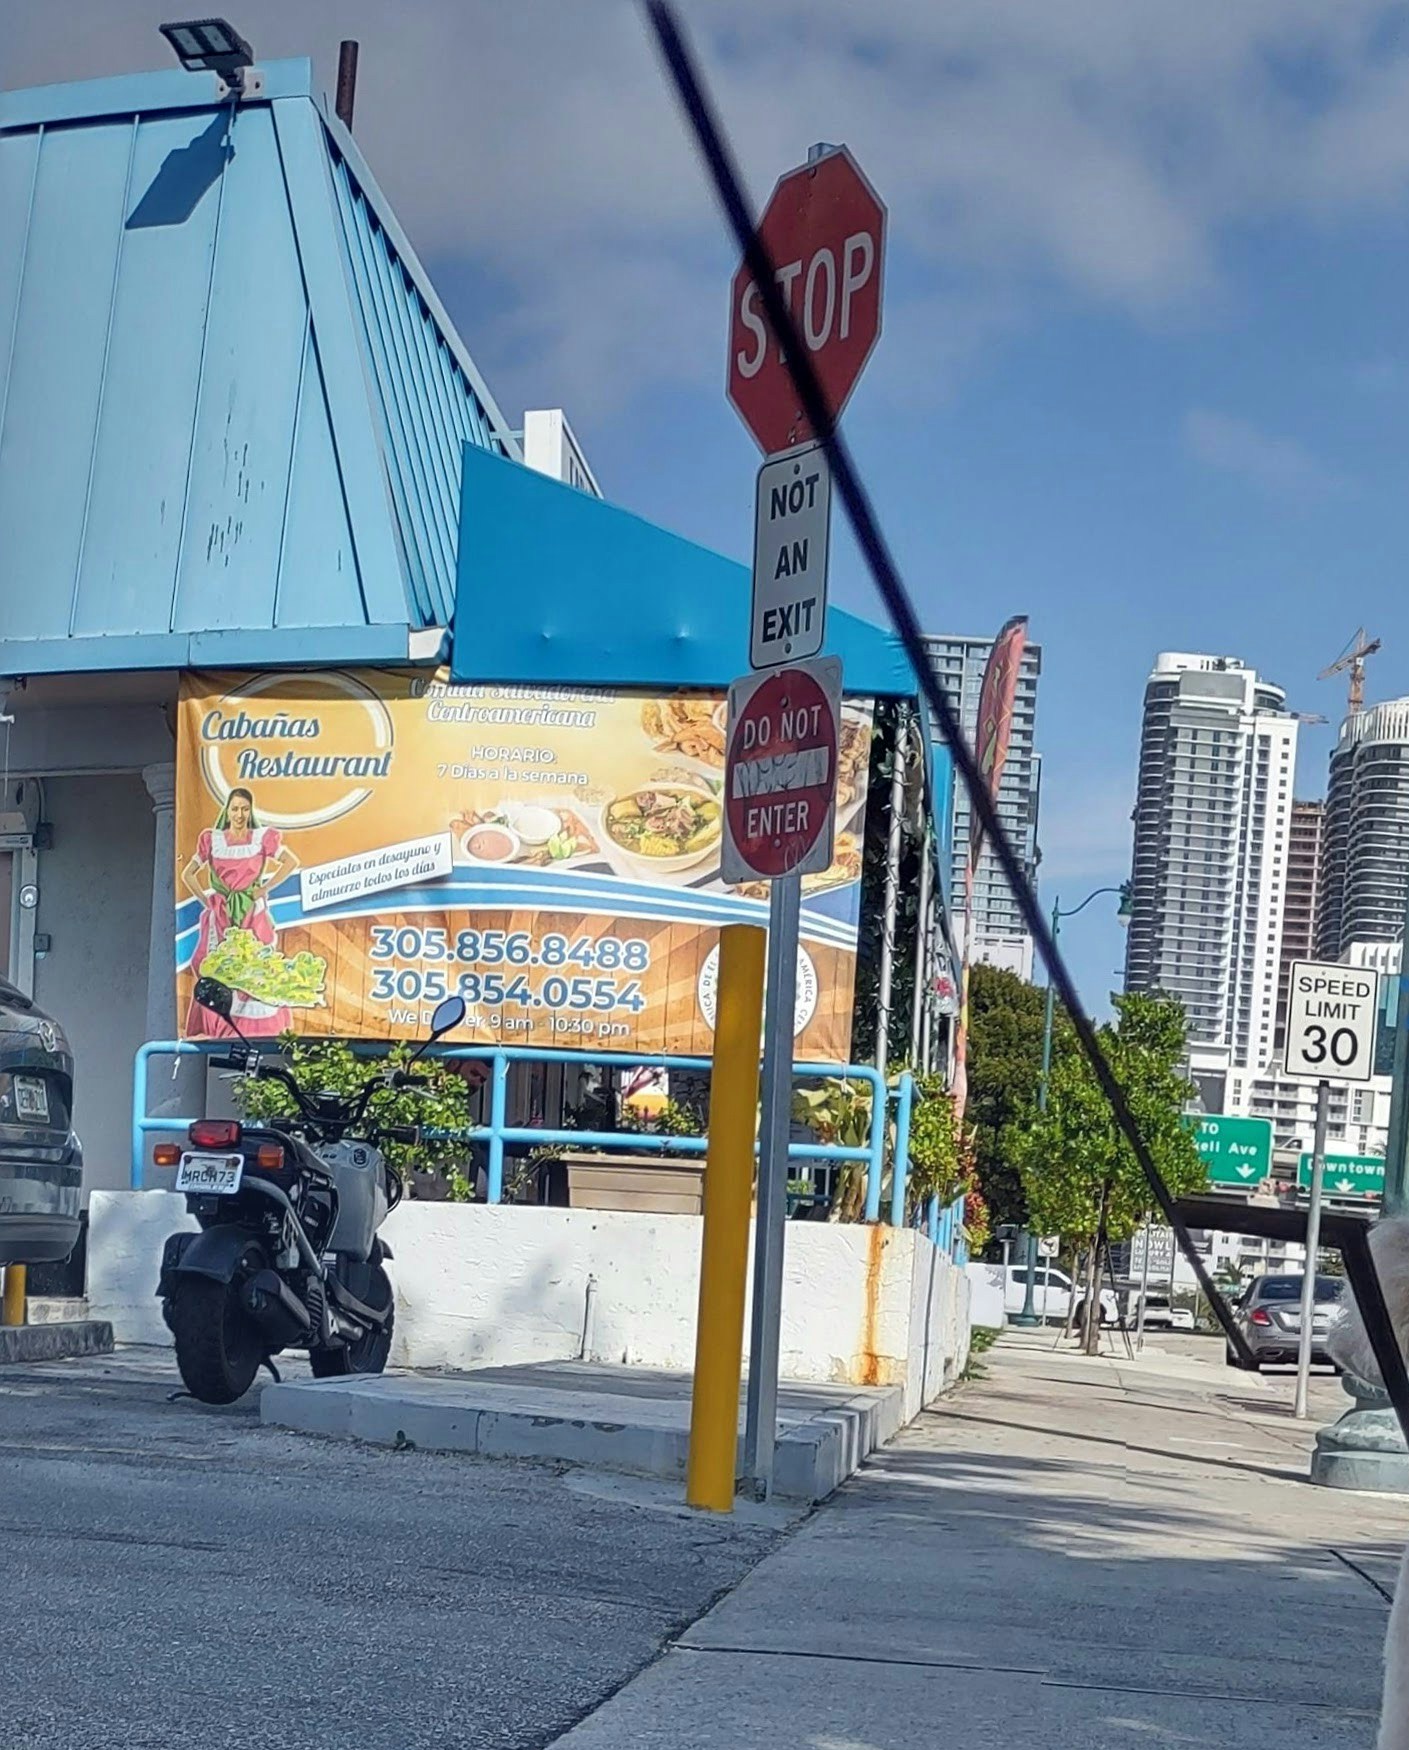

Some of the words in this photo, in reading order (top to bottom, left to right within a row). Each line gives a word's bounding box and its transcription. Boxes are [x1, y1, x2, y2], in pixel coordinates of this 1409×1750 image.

[737, 231, 874, 378] STOP
[770, 473, 819, 520] NOT
[774, 538, 808, 580] AN
[762, 597, 816, 643] EXIT
[202, 710, 320, 740] Cabañas
[427, 700, 596, 728] Centroamericana
[743, 715, 771, 750] DO
[780, 704, 822, 742] NOT
[237, 748, 392, 779] Restaurant
[437, 764, 447, 777] 7
[451, 764, 485, 780] Días
[487, 768, 499, 780] a
[504, 766, 517, 781] la
[521, 769, 588, 785] semana
[747, 800, 809, 839] ENTER
[309, 862, 362, 886] Especiales
[364, 861, 376, 871] en
[378, 844, 431, 866] desayuno
[433, 842, 442, 855] y
[311, 882, 362, 902] almuerzo
[364, 871, 393, 888] todos
[394, 866, 410, 880] los
[411, 860, 435, 875] días
[371, 927, 649, 971] 305.856.8488
[371, 969, 645, 1012] 305.854.0554
[1298, 976, 1370, 998] SPEED
[388, 1008, 417, 1026] We
[421, 1009, 483, 1029] Dver
[490, 1014, 500, 1028] 9
[504, 1017, 533, 1030] am
[549, 1016, 594, 1033] 10:30
[599, 1021, 630, 1036] pm
[1305, 1000, 1361, 1020] LIMIT
[1301, 1025, 1358, 1066] 30
[1201, 1121, 1219, 1135] TO
[1228, 1142, 1258, 1156] Ave
